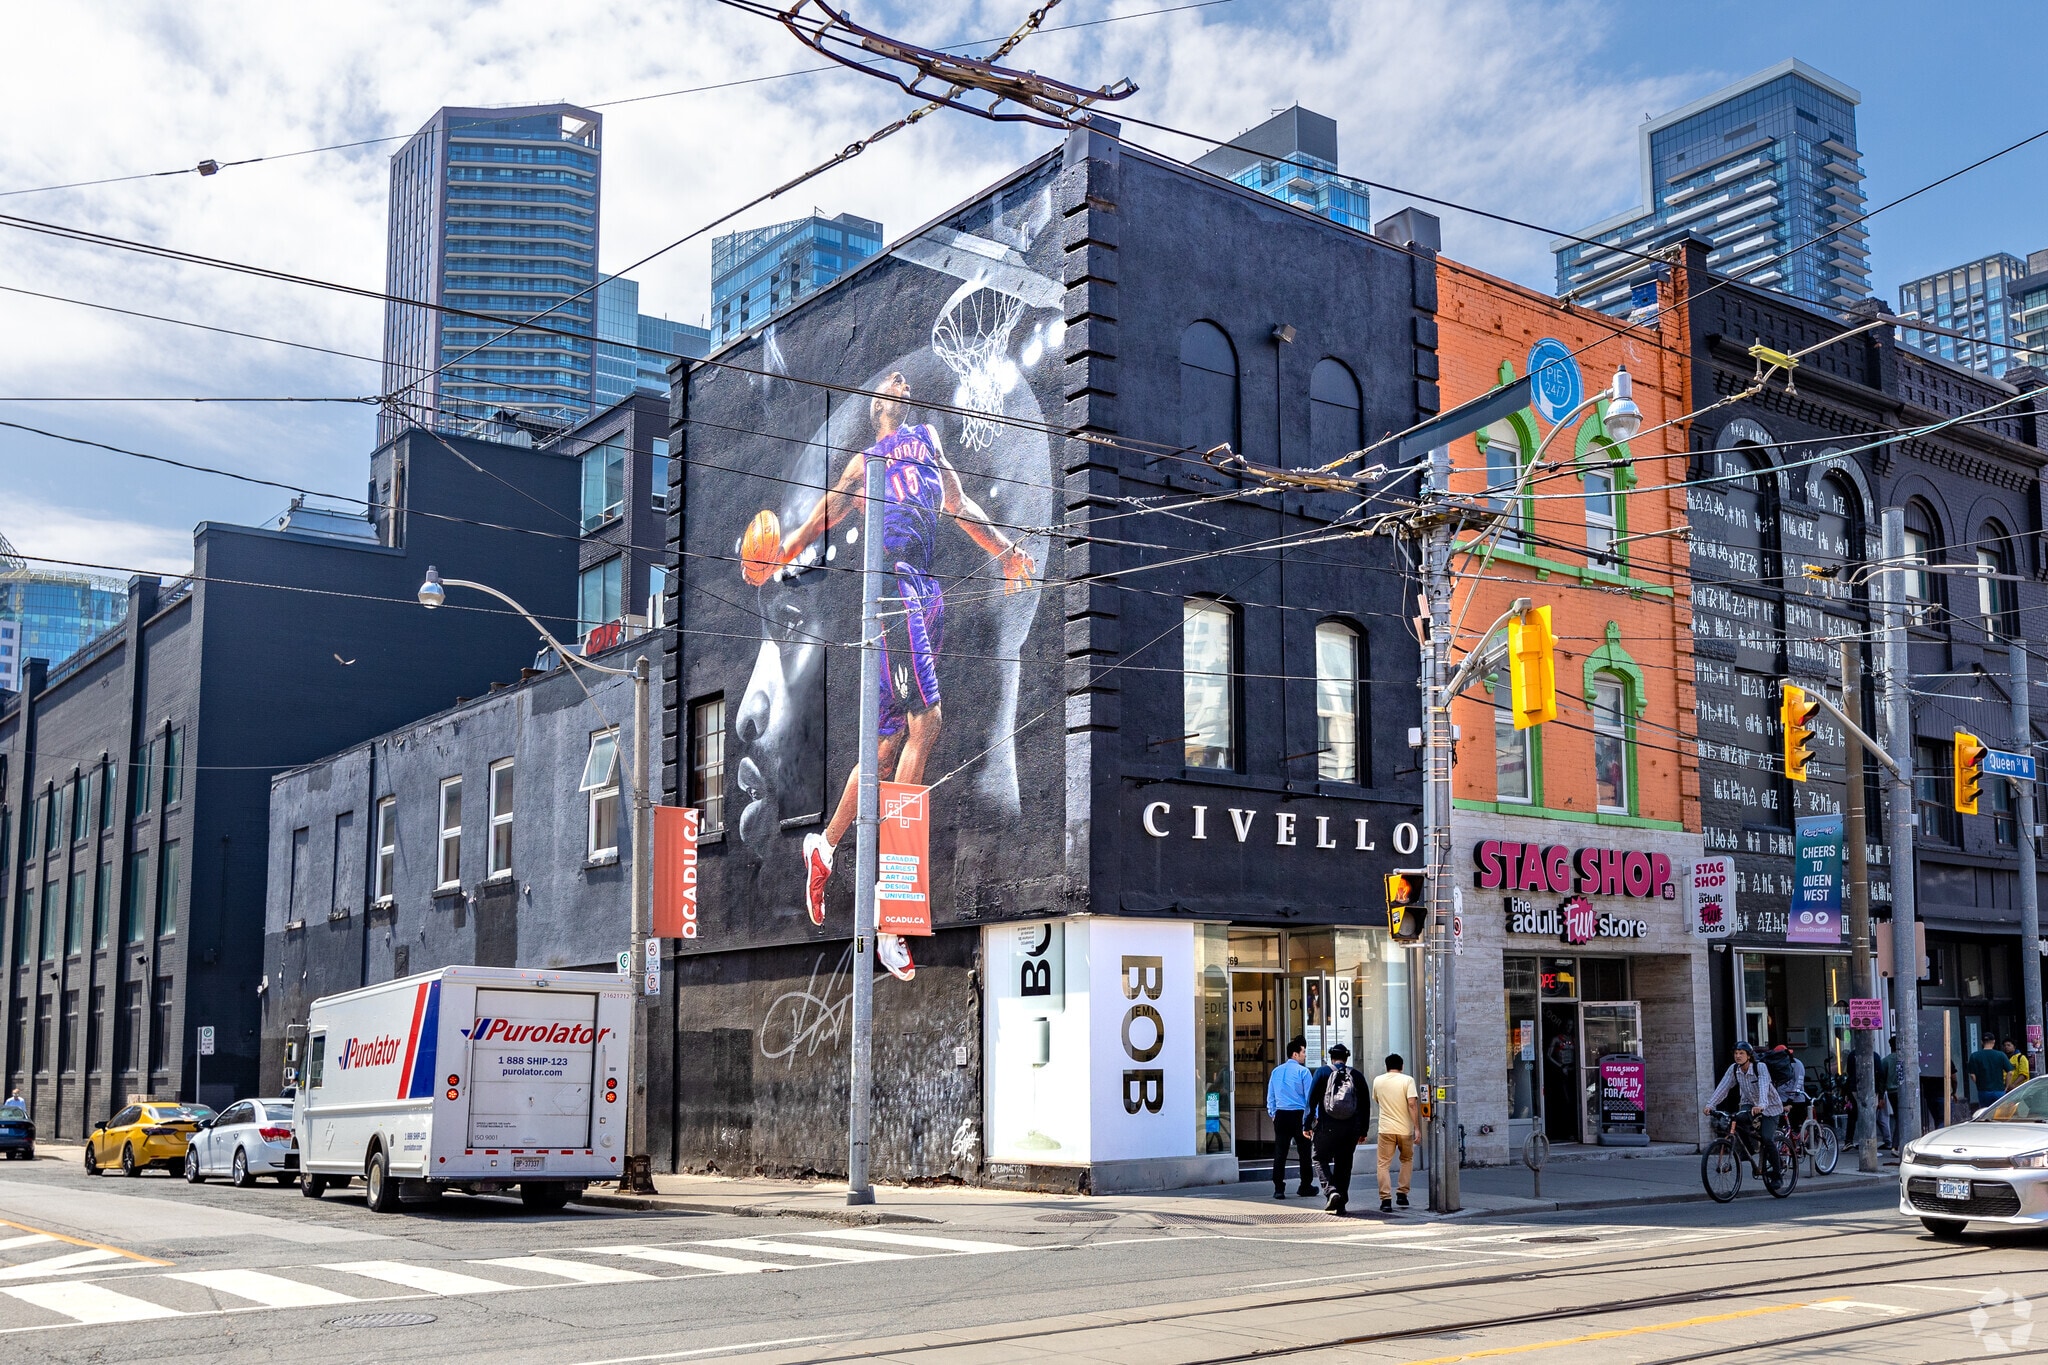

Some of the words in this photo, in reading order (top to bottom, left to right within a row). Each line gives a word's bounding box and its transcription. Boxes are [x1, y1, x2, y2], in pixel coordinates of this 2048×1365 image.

[1546, 367, 1563, 384] PIE
[1545, 382, 1566, 398] 24/7
[885, 440, 926, 469] RONTO
[891, 465, 920, 503] 15
[1990, 753, 2016, 771] Queen
[2022, 758, 2029, 773] W
[1142, 801, 1419, 855] CIVELLO
[1802, 845, 1836, 859] CHEERS
[682, 809, 699, 939] OCADU.CA
[1476, 840, 1571, 893] STAG
[1576, 847, 1672, 898] SHOP
[1695, 862, 1724, 875] STAG
[1812, 860, 1823, 873] TO
[1694, 875, 1726, 888] SHOP
[1803, 874, 1832, 888] QUEEN
[1698, 893, 1723, 904] adult
[1803, 889, 1830, 902] WEST
[1511, 897, 1532, 913] the
[885, 916, 925, 924] OCADU.CA
[1512, 909, 1564, 934] adult
[1564, 903, 1597, 942] Fun
[1599, 913, 1647, 938] store
[1698, 924, 1726, 933] store
[1339, 980, 1350, 1019] BOB
[486, 1018, 611, 1044] Purolator
[1121, 955, 1165, 1114] BOB
[347, 1034, 401, 1069] Purolator
[498, 1056, 504, 1065] 1
[506, 1057, 524, 1065] 888
[527, 1057, 568, 1066] SHIP-123
[502, 1067, 563, 1077] purolator.com
[1608, 1077, 1628, 1087] COME
[1629, 1077, 1638, 1087] IN
[1604, 1088, 1618, 1098] FOR
[1618, 1084, 1642, 1099] Fun!
